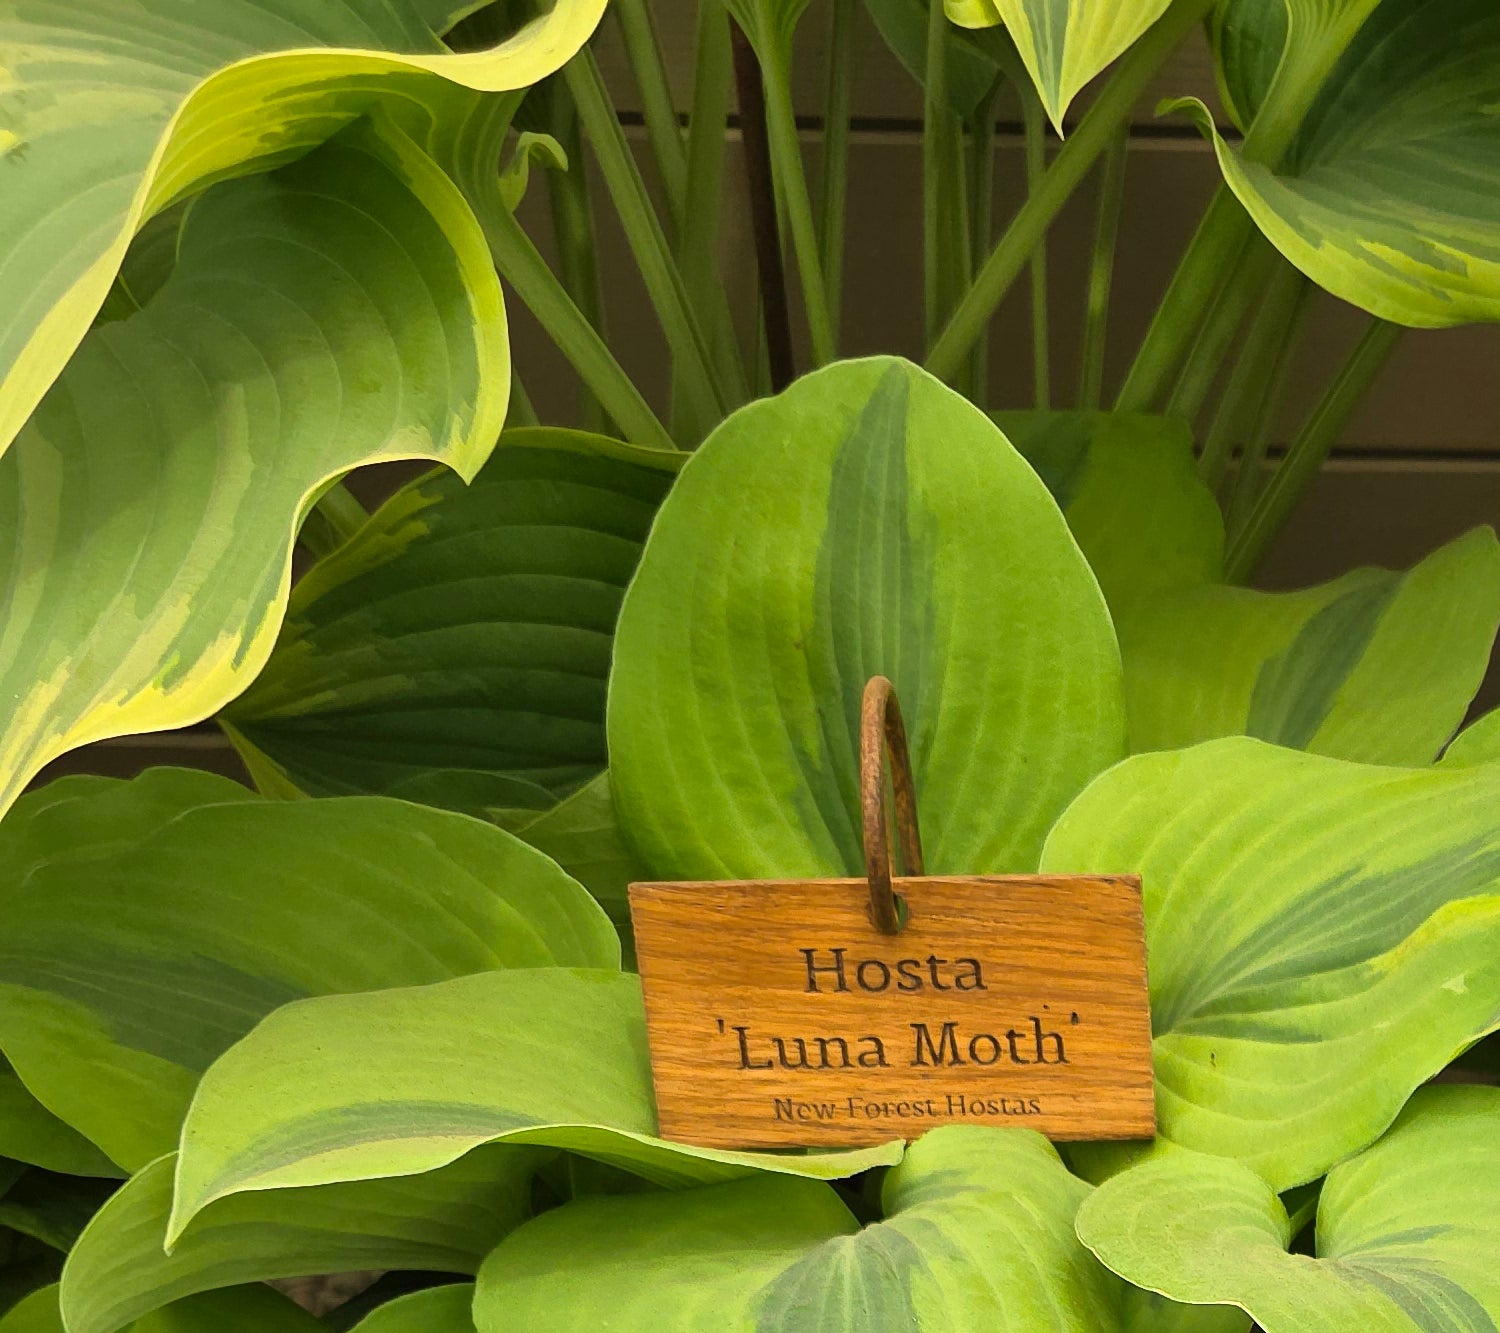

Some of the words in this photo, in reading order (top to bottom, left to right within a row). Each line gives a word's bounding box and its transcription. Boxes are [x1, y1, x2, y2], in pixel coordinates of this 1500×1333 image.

[800, 947, 988, 994] Hosta
[716, 1019, 890, 1070] 'Luna
[909, 1011, 1080, 1068] Moth'
[774, 1098, 835, 1121] New
[846, 1097, 935, 1119] Forest
[945, 1095, 1042, 1117] Hostas
